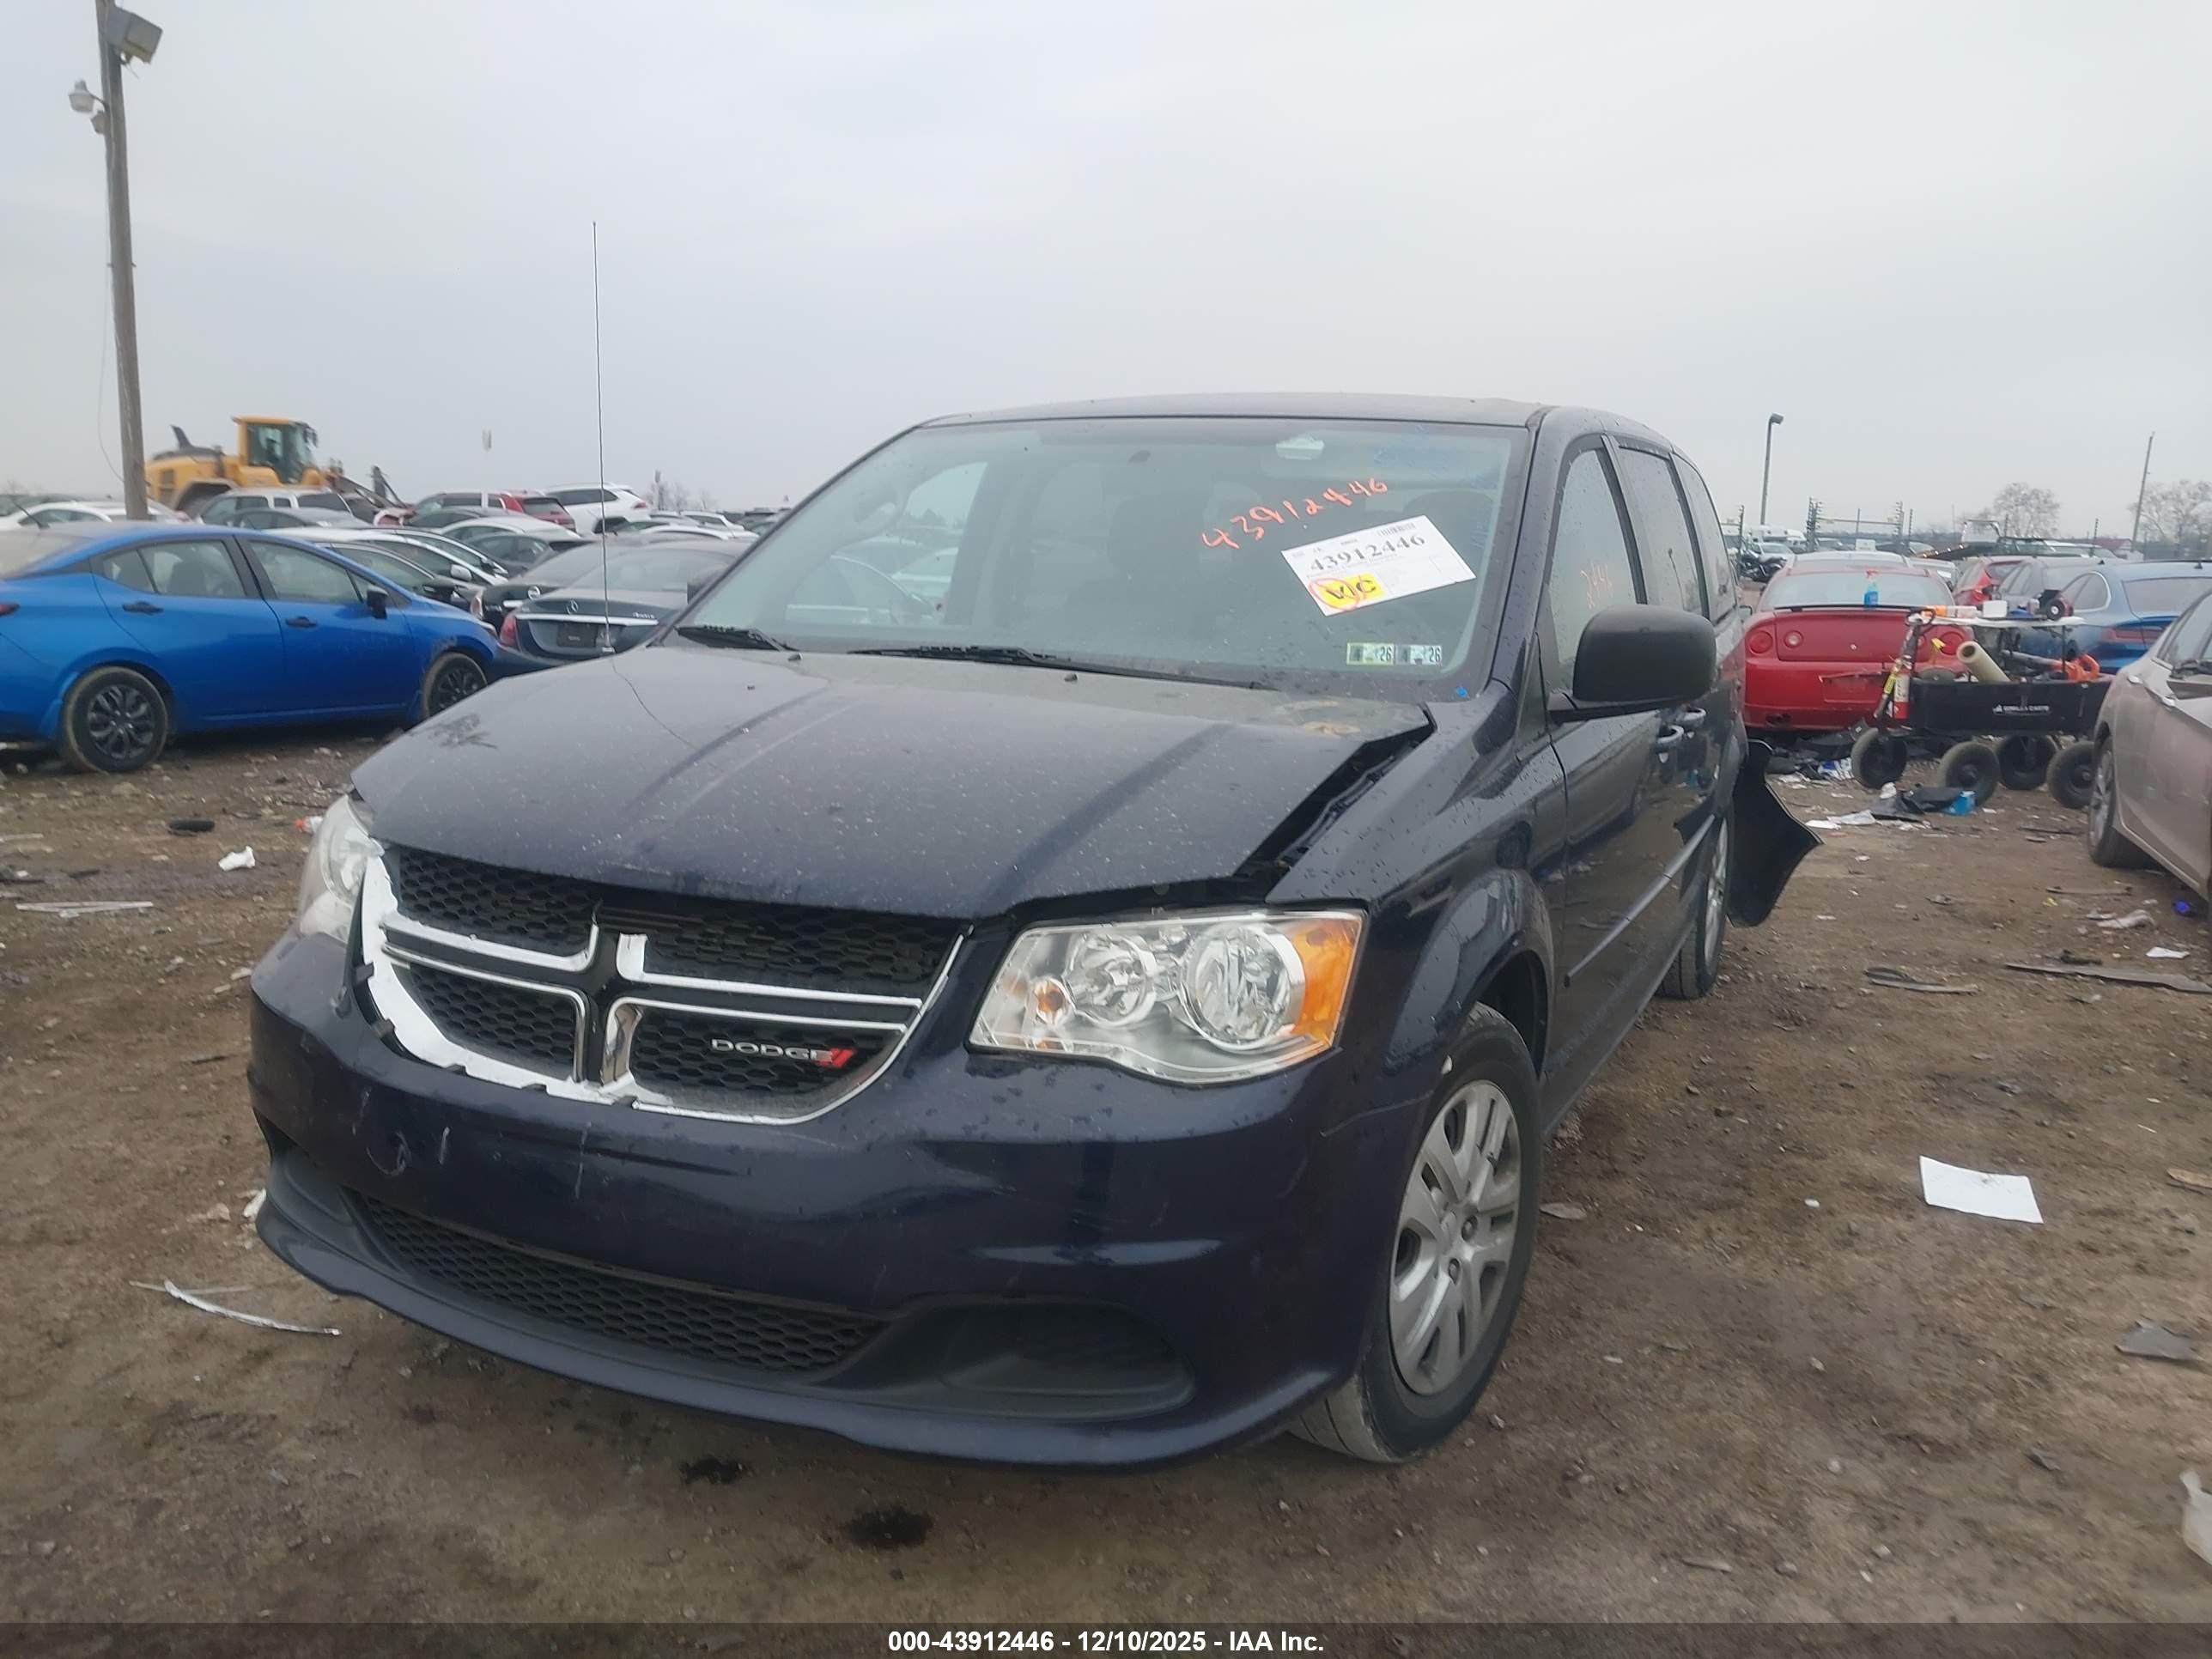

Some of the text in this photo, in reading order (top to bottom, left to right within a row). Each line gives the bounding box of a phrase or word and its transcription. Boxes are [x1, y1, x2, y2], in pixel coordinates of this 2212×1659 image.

[1202, 477, 1388, 549] 43912446
[1310, 534, 1425, 571] 43912446
[1380, 646, 1392, 662] 26
[1429, 647, 1442, 663] 26
[711, 1038, 834, 1064] DODGE
